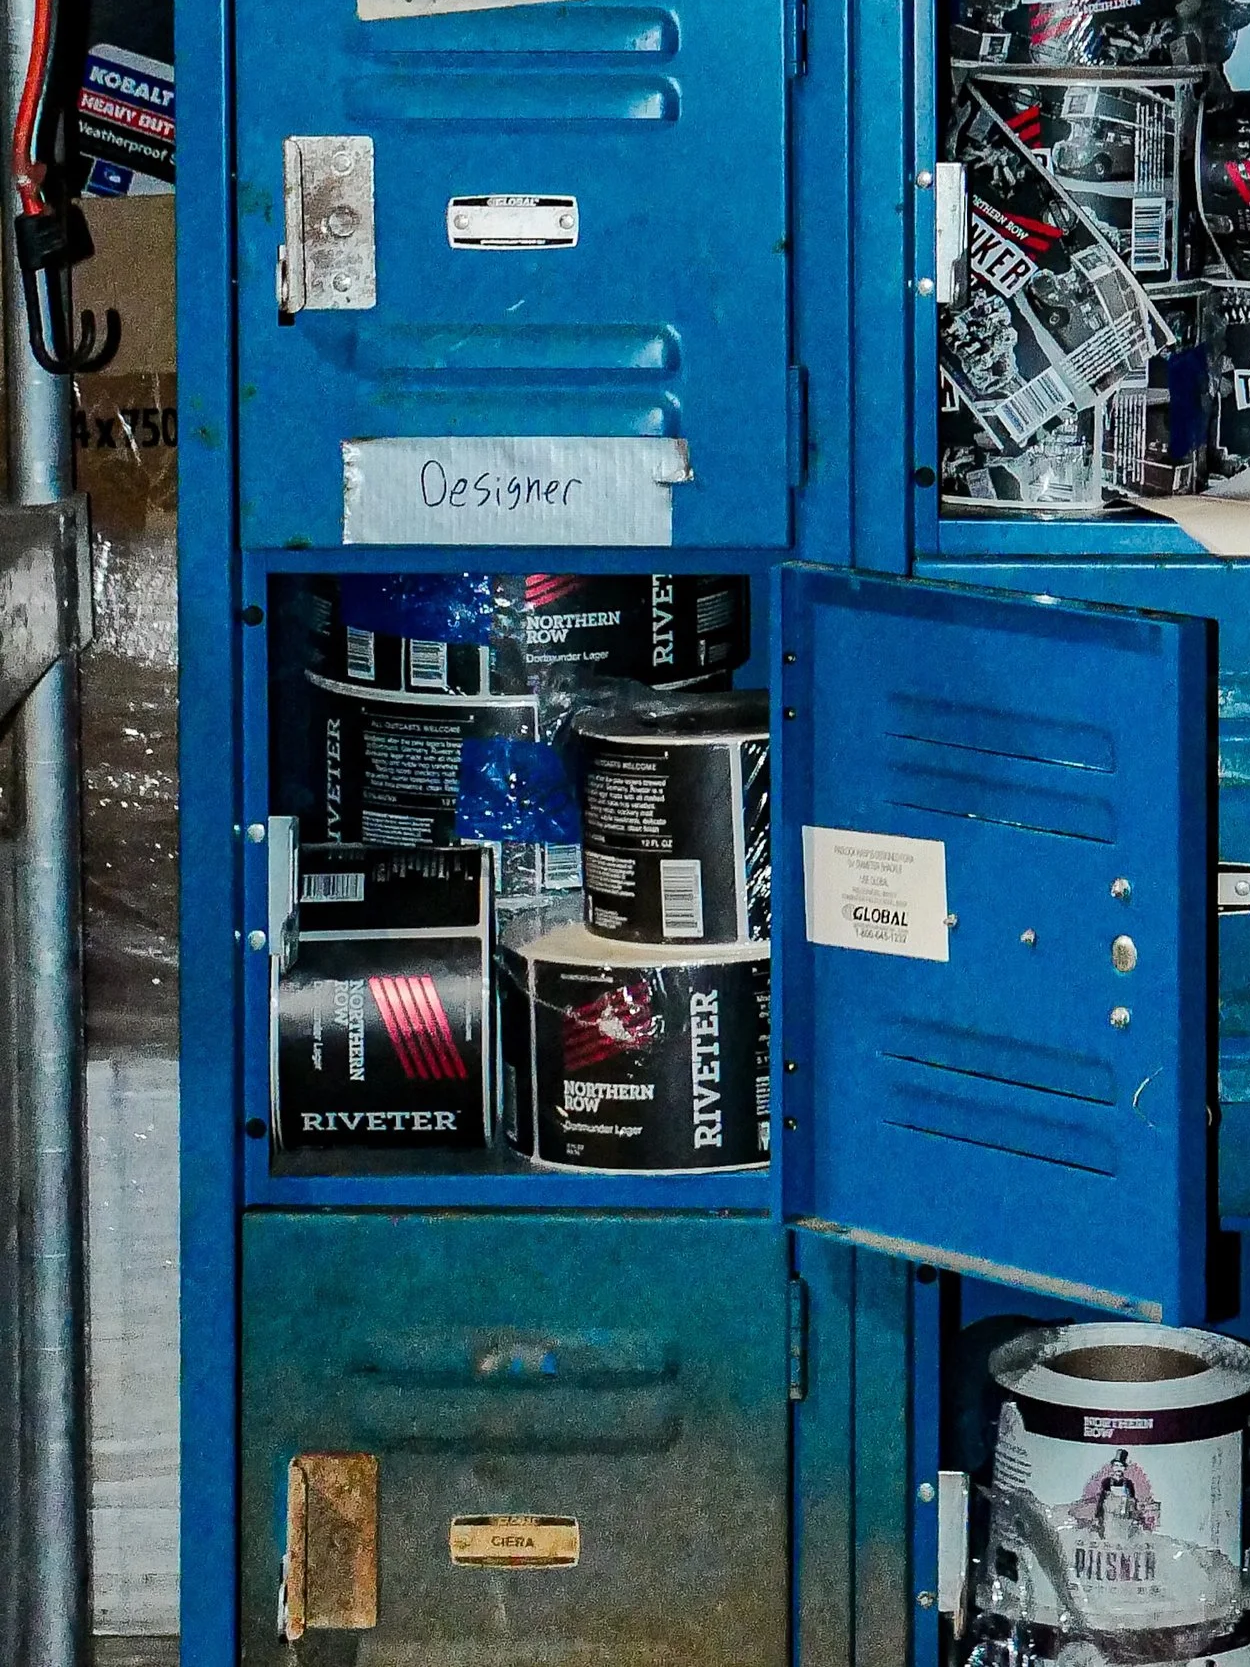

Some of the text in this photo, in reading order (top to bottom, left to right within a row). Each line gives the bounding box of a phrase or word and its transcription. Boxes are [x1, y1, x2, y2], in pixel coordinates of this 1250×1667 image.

[89, 65, 174, 107] KOBALT
[80, 93, 176, 137] HEAVY DUT
[972, 195, 1029, 240] RTHERN ROW
[971, 221, 1032, 291] NKER
[420, 460, 582, 510] Designer
[526, 611, 621, 630] NORTHERN
[526, 628, 569, 645] ROW
[583, 650, 609, 663] Lager
[327, 718, 341, 844] IVETER
[853, 906, 908, 926] GLOBAL
[334, 980, 348, 1026] ROW
[349, 979, 365, 1081] NORTHERN
[564, 1080, 654, 1100] NORTHERN
[690, 990, 723, 1149] RIVETER
[301, 1111, 458, 1133] RIVETER
[564, 1097, 600, 1113] ROW
[1074, 1548, 1155, 1581] PILSNER
